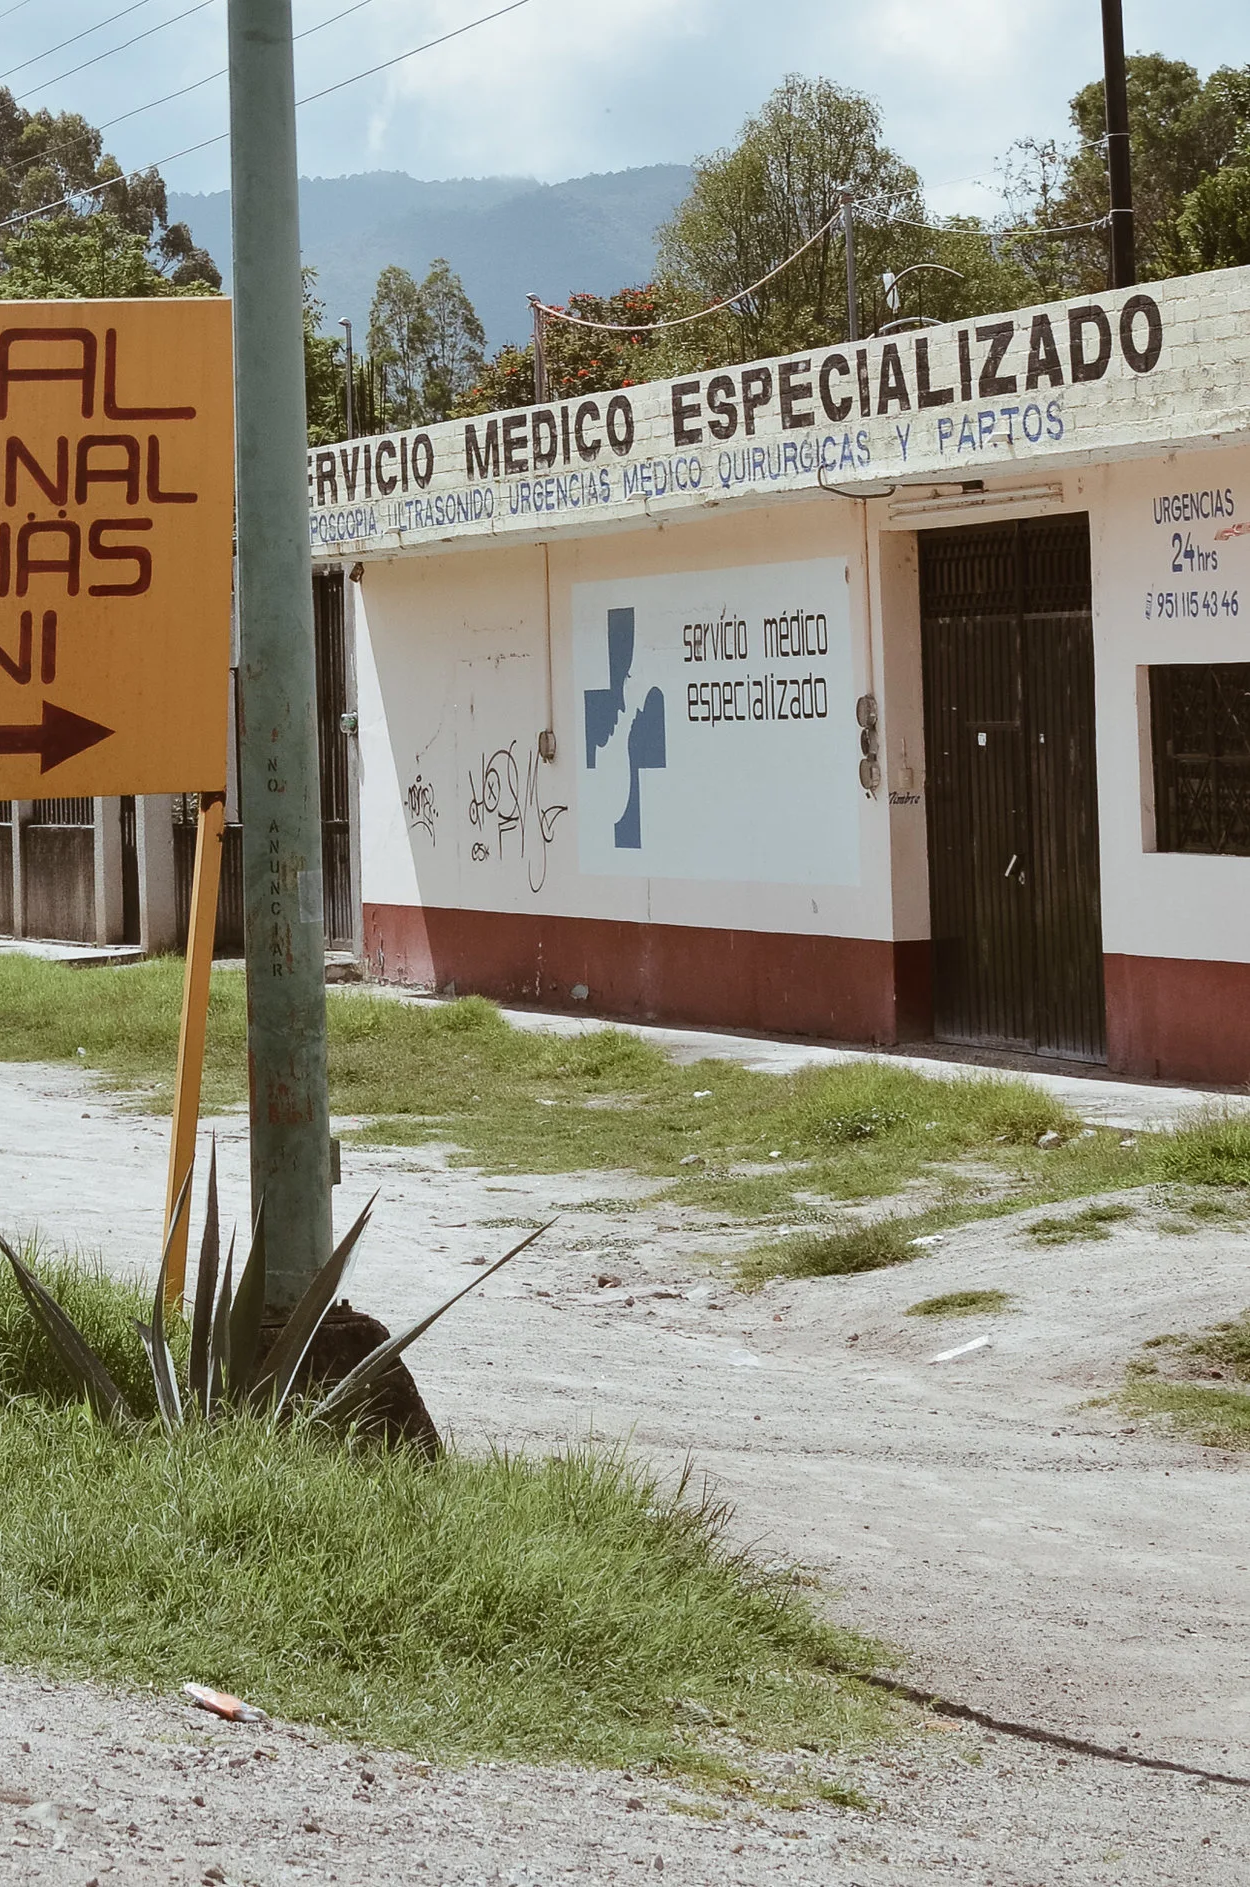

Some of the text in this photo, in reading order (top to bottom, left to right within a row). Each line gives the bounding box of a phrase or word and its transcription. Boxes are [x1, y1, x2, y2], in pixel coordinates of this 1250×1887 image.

[308, 294, 1163, 508] RVICIO MEDICO ESPECIALIZADO
[310, 506, 384, 544] POSCOPIA,
[509, 468, 611, 515] URGENCIAS
[623, 455, 702, 498] MEDICO
[718, 428, 872, 489] QUIRURGICAS
[895, 423, 912, 462] Y
[938, 400, 1065, 455] PARTOS
[1153, 488, 1235, 525] URGENCIAS
[1171, 532, 1219, 573] 24 hrs
[1202, 591, 1218, 617] 43
[1221, 590, 1239, 616] 46
[763, 609, 828, 659] médico
[687, 672, 828, 728] especializado
[268, 819, 284, 978] ANUNCIAR
